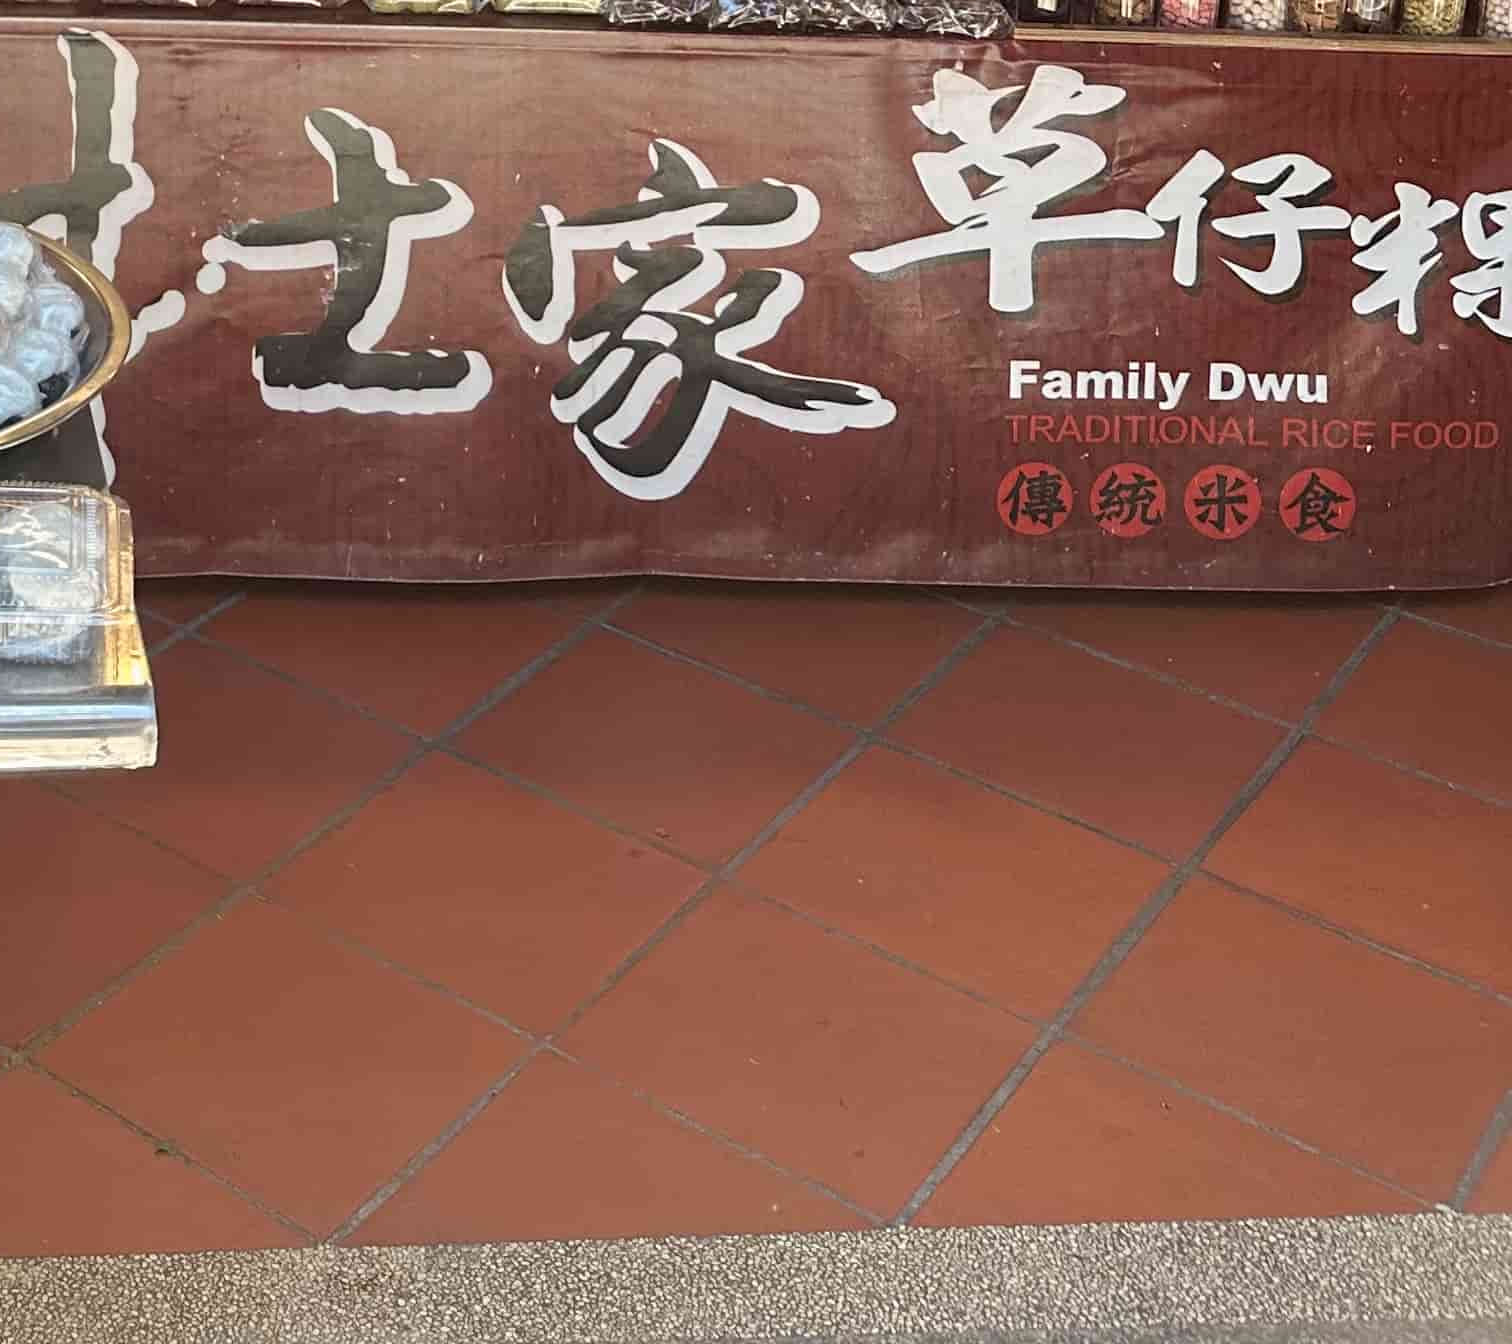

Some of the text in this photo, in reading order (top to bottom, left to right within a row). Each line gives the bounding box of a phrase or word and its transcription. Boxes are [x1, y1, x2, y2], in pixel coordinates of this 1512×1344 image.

[1008, 360, 1329, 410] Family Dwu
[1005, 415, 1501, 449] TRADITIONAL RICE FOOD
[997, 461, 1358, 541] 傳統米食
